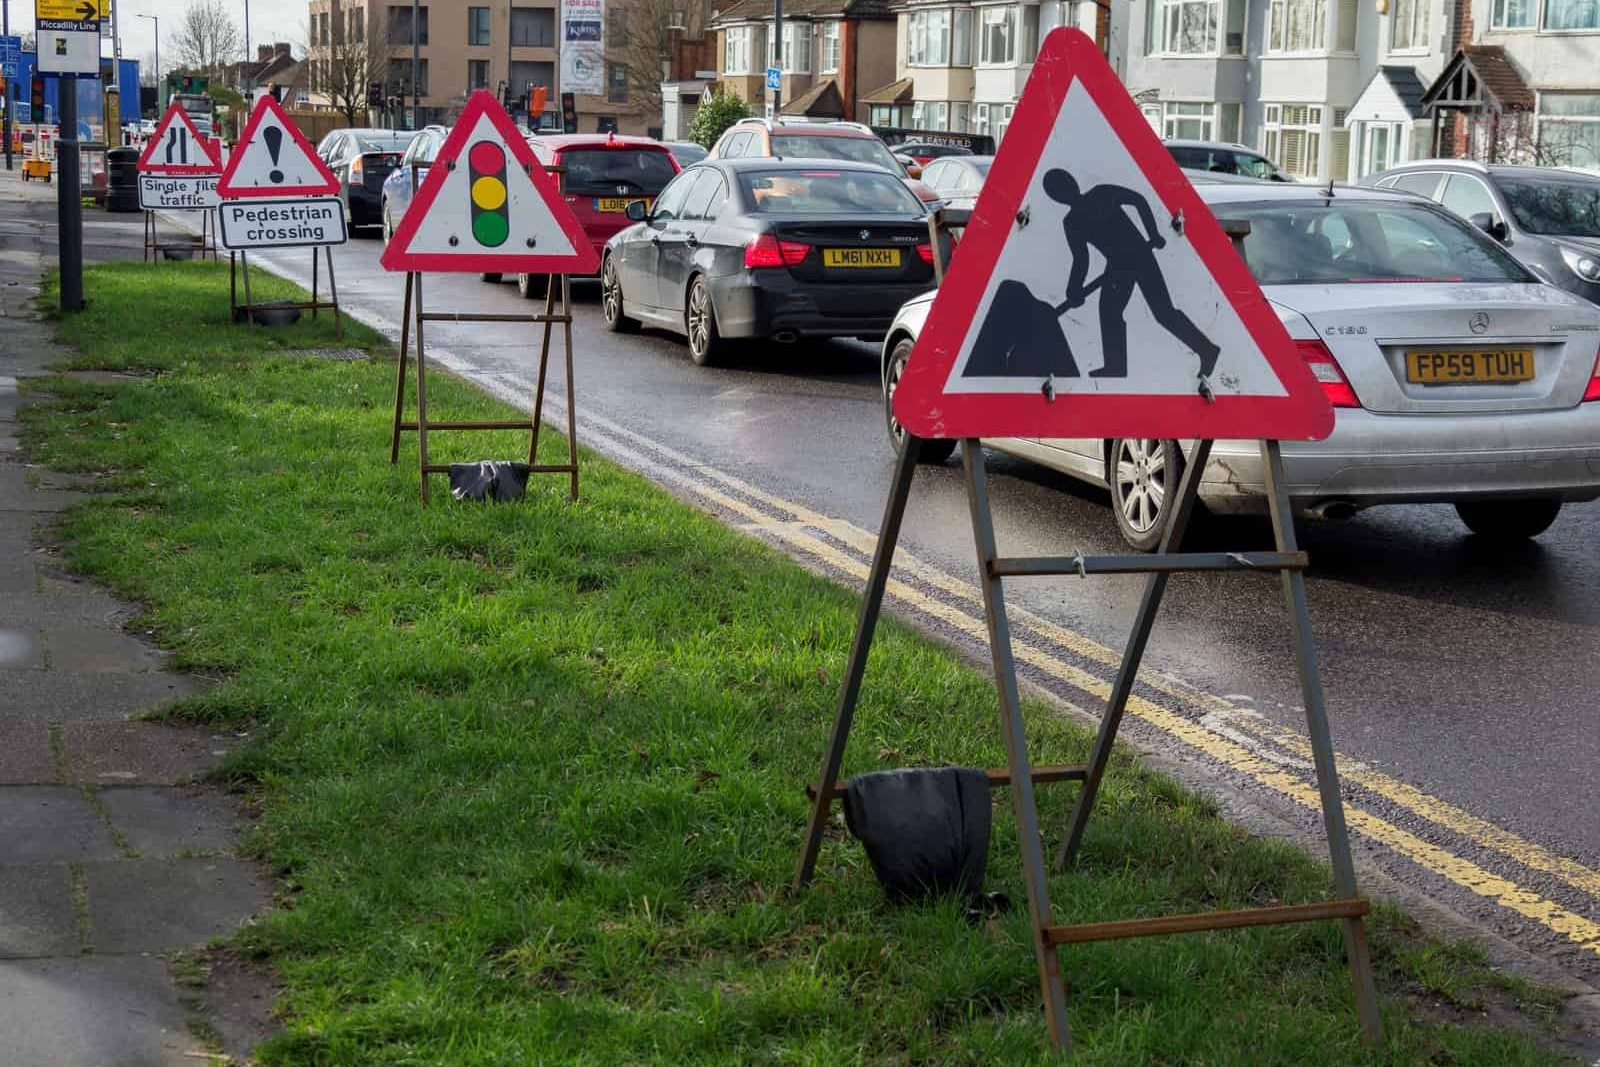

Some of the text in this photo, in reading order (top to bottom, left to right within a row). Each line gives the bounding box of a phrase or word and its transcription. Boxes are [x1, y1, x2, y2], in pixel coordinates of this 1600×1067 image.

[40, 20, 97, 31] Piccadilly Line
[144, 179, 217, 194] Single file
[160, 193, 205, 206] traffic
[232, 206, 333, 223] Pedestrian
[246, 224, 325, 241] crossing
[832, 250, 892, 264] LM61 NXH
[1416, 353, 1525, 378] FP59 TUH
